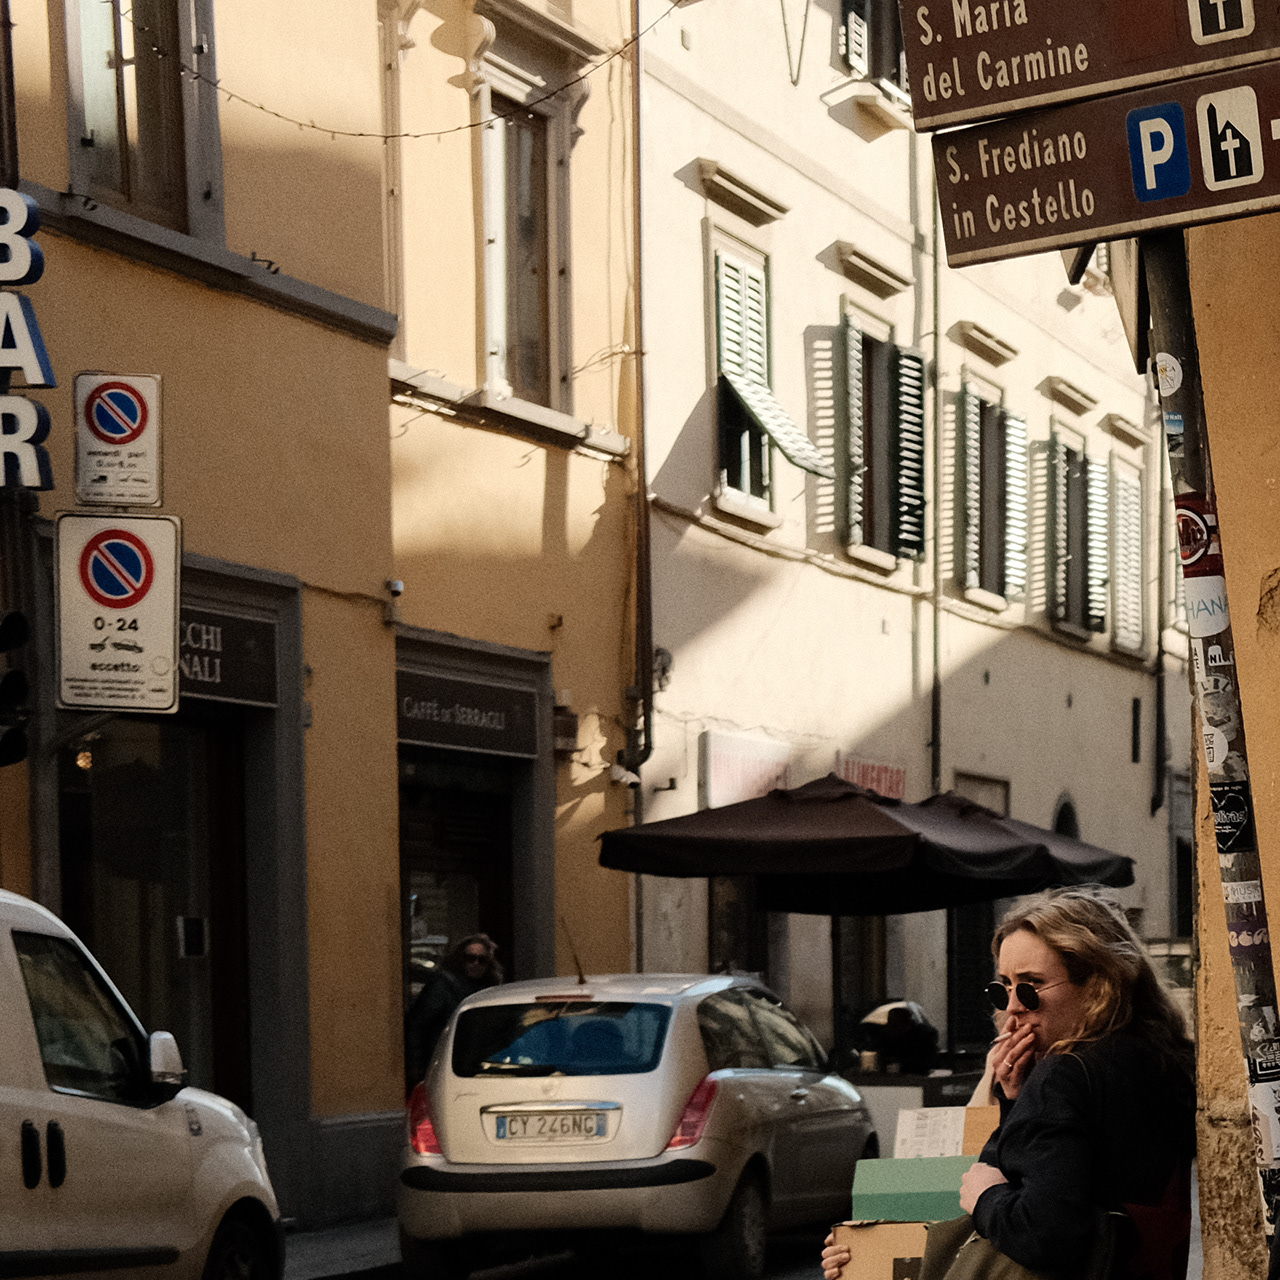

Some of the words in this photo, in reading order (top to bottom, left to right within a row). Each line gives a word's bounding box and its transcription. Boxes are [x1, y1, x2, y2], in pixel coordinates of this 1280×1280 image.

[917, 5, 943, 46] S.
[954, 0, 1028, 40] Maria
[923, 56, 966, 102] del
[977, 38, 1090, 92] Carmine
[946, 145, 971, 185] S.
[979, 129, 1088, 179] Frediano
[952, 203, 977, 240] in
[985, 178, 1096, 234] Cestello
